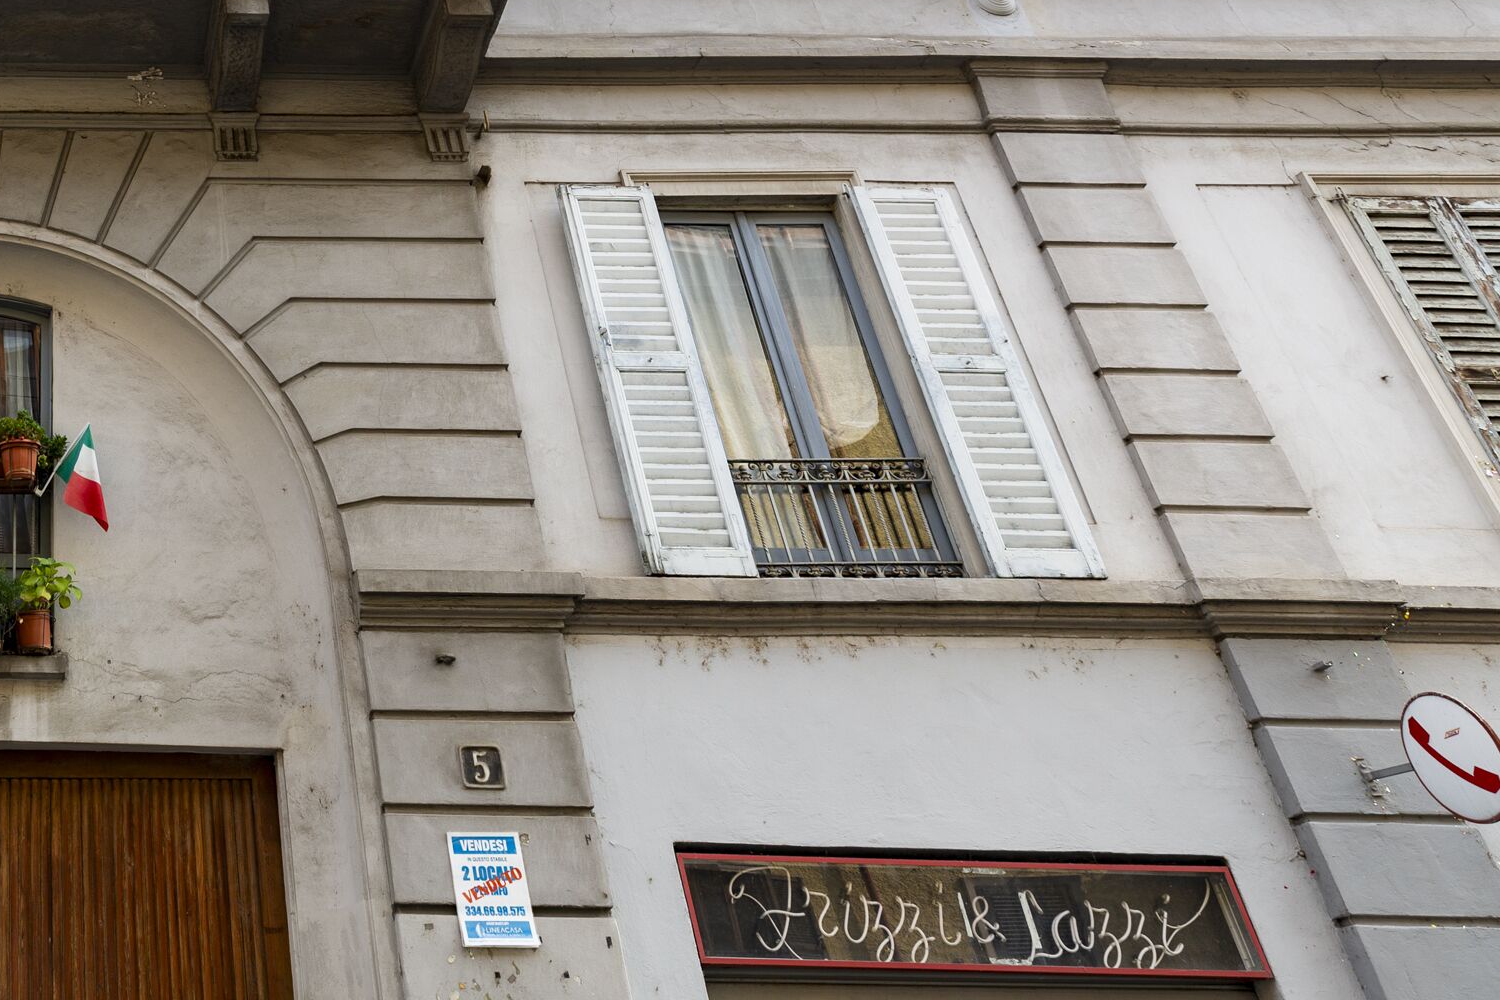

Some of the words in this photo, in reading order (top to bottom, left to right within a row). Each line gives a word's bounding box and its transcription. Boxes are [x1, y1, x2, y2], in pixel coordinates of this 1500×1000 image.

[472, 751, 491, 783] 5
[460, 839, 508, 852] VENDESI
[461, 865, 471, 881] 2
[472, 865, 515, 881] LOCA
[462, 867, 523, 904] VENDUTO
[972, 896, 1007, 944] &
